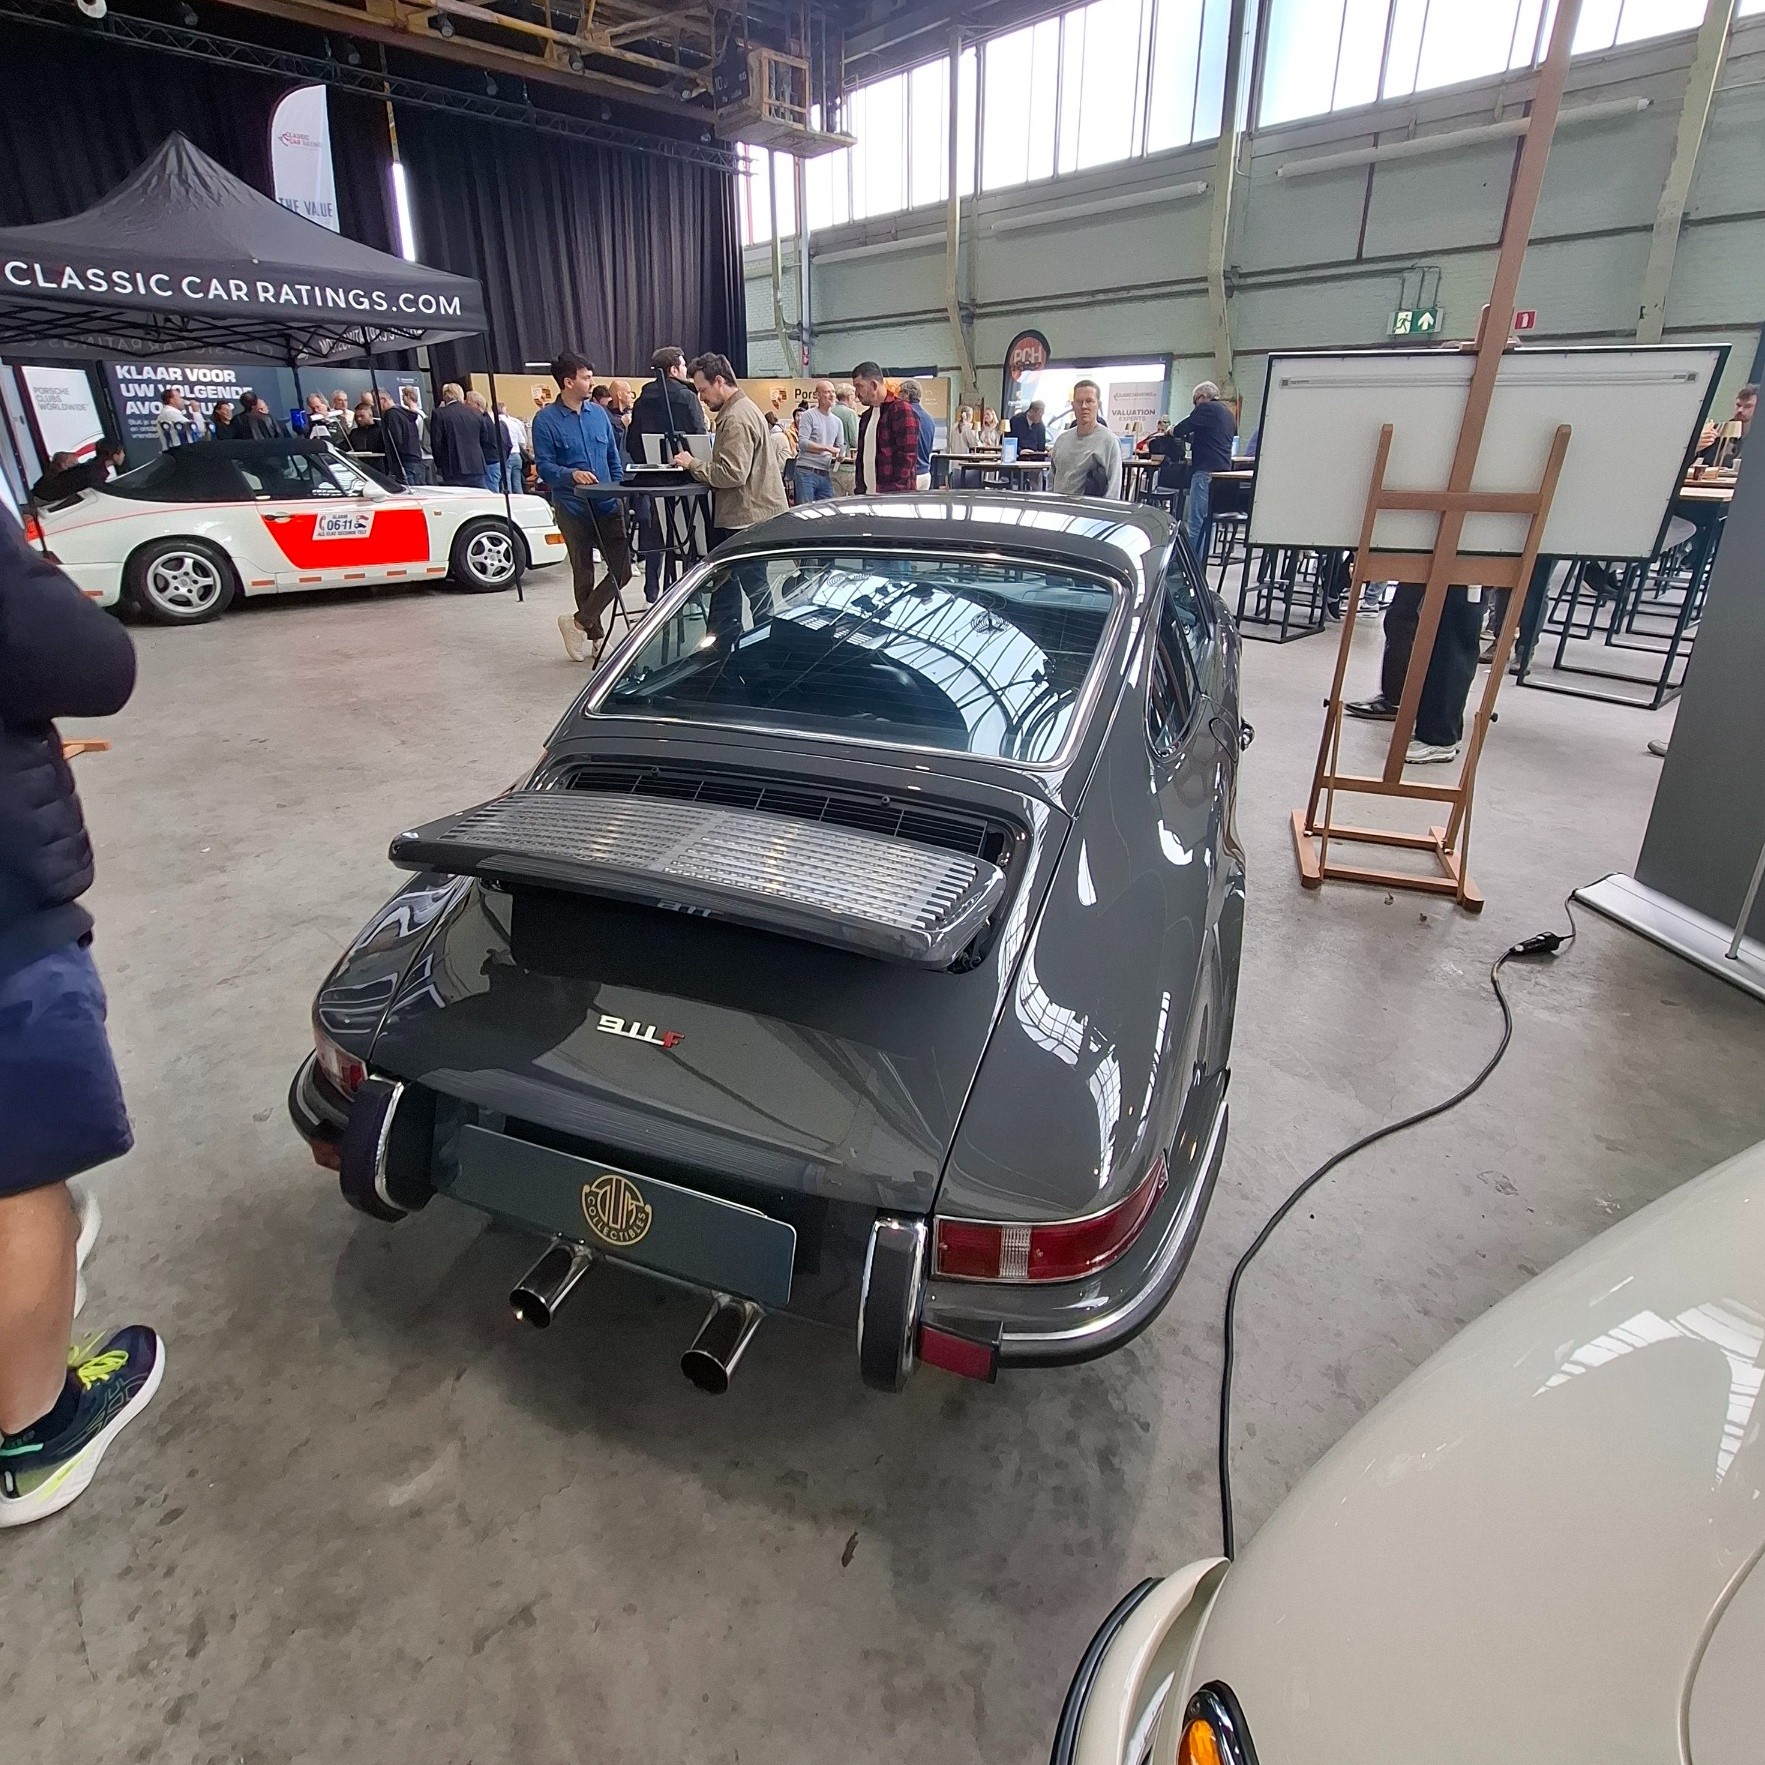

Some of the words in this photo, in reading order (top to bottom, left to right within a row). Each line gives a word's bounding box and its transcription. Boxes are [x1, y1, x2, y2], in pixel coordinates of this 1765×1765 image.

[303, 201, 333, 217] VALUE
[4, 261, 174, 297] CLASSIC
[181, 276, 250, 302] CAR
[256, 281, 462, 316] RATINGS.COM
[115, 365, 184, 381] KLAAR
[184, 368, 237, 383] VOOR
[33, 386, 71, 396] PORSCHE
[119, 383, 156, 398] UW
[794, 388, 819, 400] Pors
[36, 394, 63, 403] CLUBS
[38, 402, 88, 412] WORLDWIDE
[1111, 408, 1156, 416] VALUATION
[327, 519, 353, 530] 06-11
[587, 1195, 646, 1241] COLLECTIBLES
